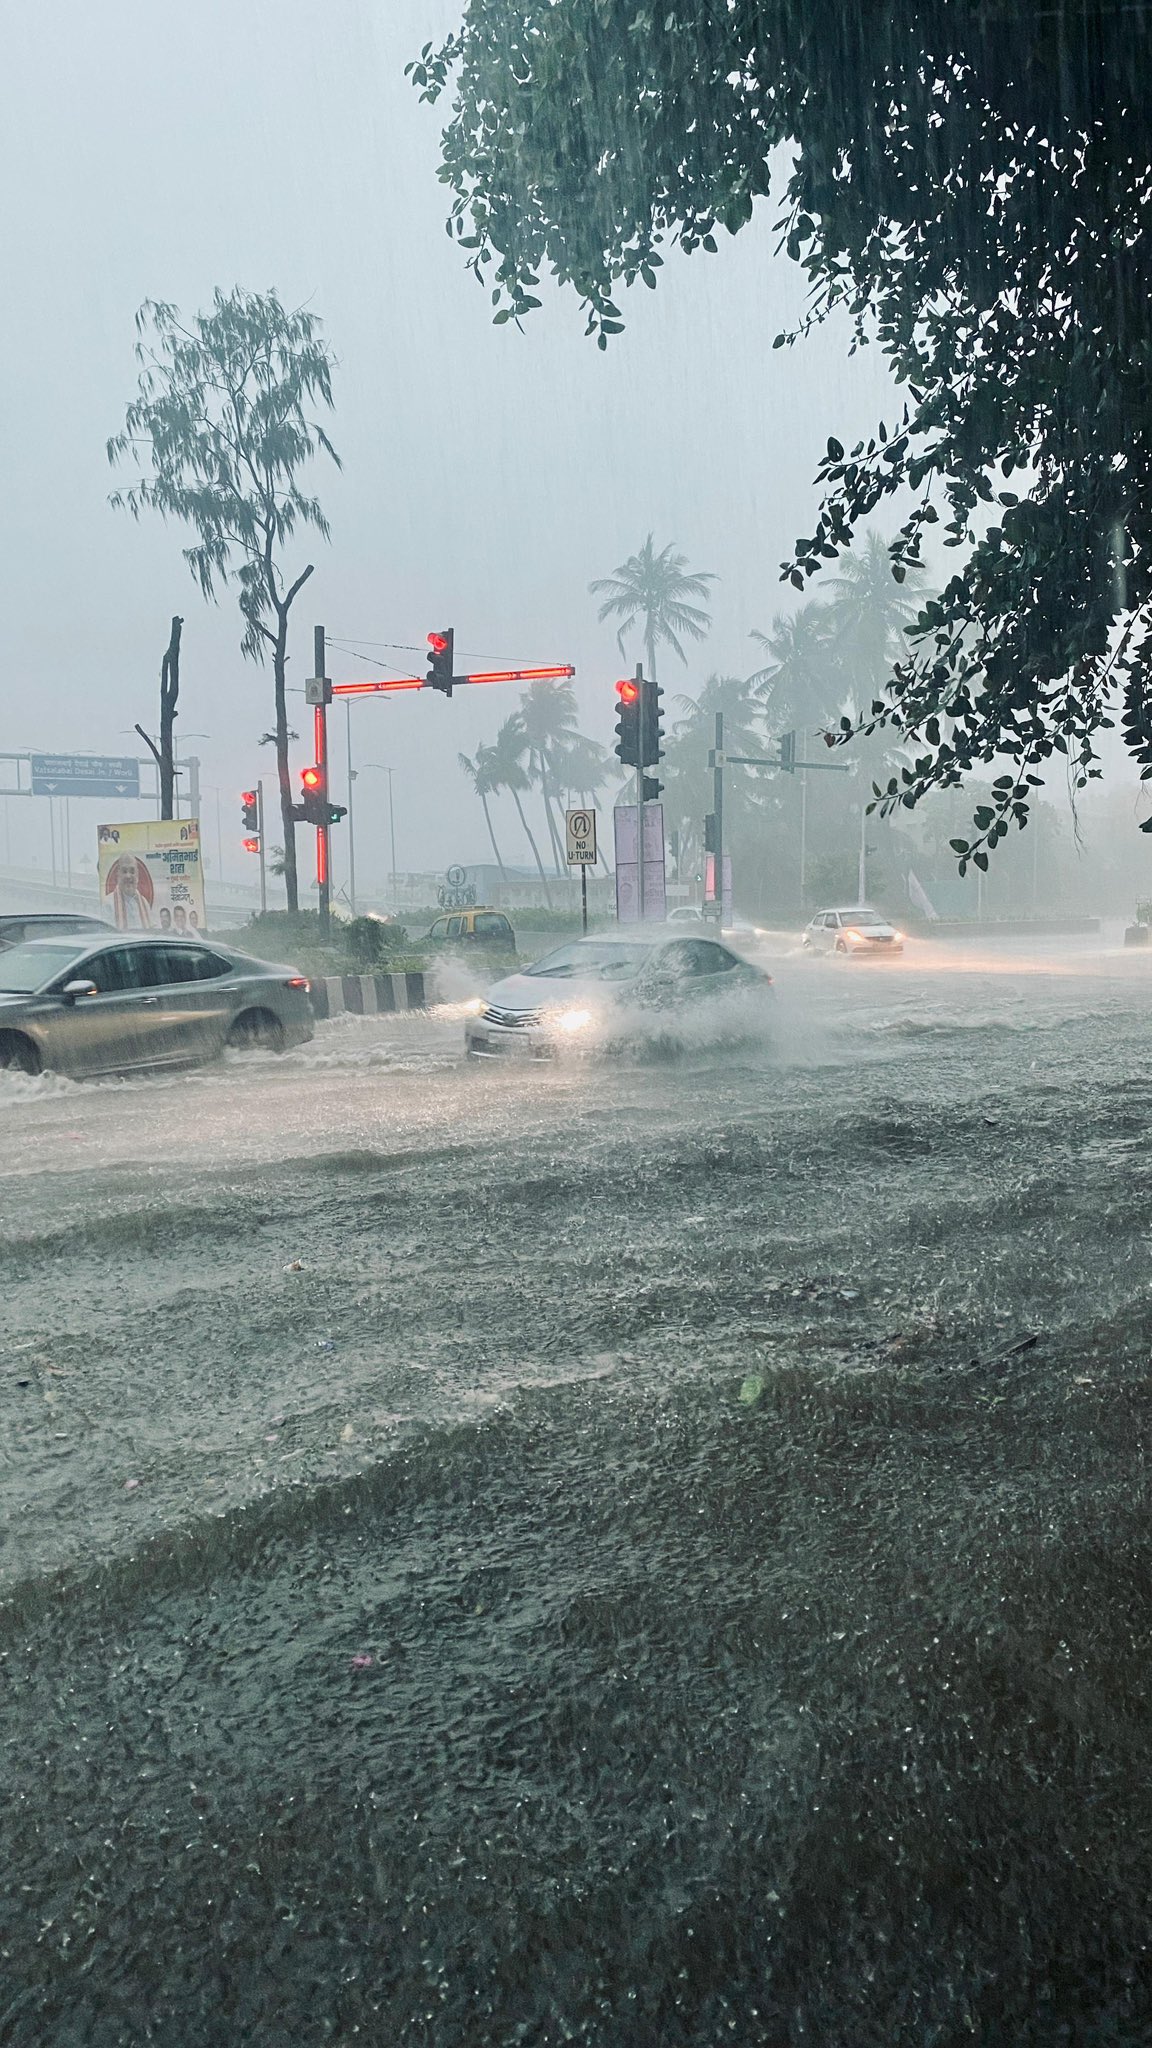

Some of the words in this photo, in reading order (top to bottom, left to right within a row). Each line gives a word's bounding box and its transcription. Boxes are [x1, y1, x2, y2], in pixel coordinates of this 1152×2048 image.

[74, 767, 95, 776] Desai
[576, 841, 586, 850] NO
[568, 851, 594, 860] U-TURN
